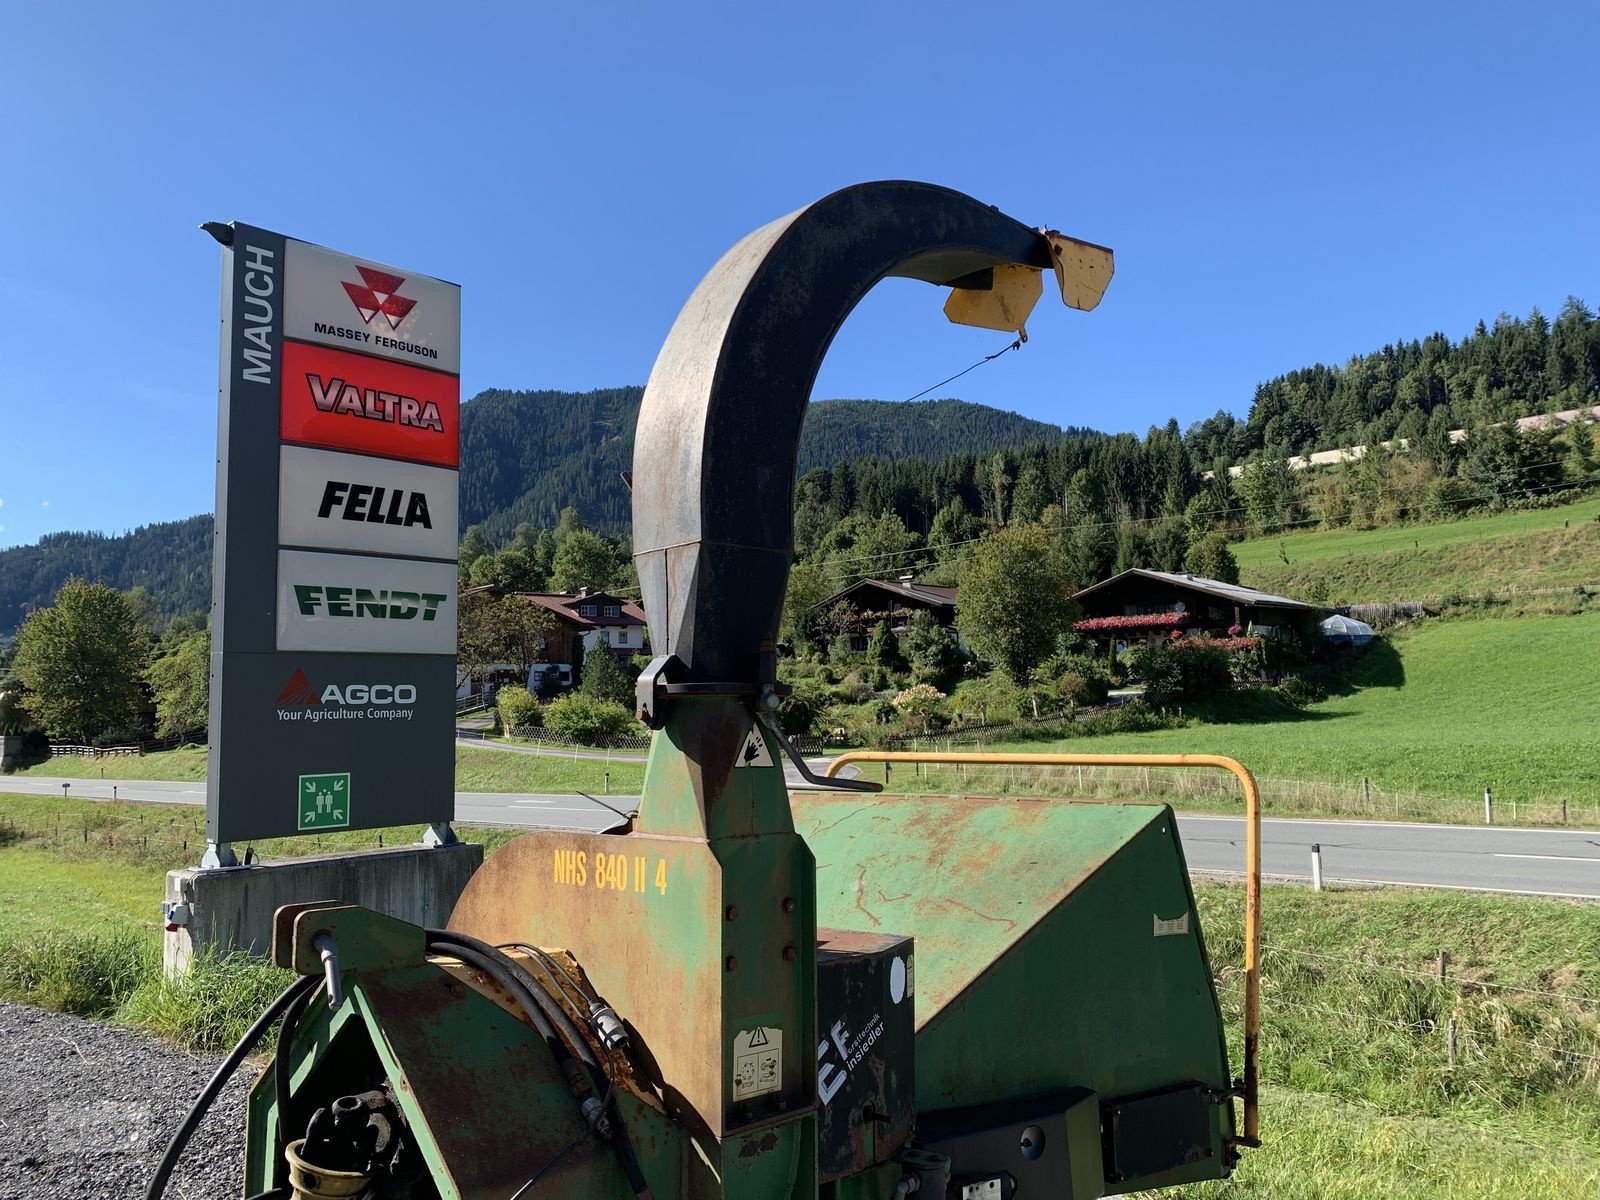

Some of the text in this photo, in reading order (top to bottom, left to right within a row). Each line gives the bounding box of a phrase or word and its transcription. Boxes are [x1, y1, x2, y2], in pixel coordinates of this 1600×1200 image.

[242, 244, 275, 385] MAUCH
[314, 322, 438, 360] MASSEY FERGUSON
[305, 373, 445, 433] VALTRA
[317, 481, 433, 530] FELLA
[293, 584, 448, 621] FENDT
[320, 684, 417, 705] AGCO
[276, 708, 414, 723] Your Agriculture Company
[595, 852, 628, 892] 840
[655, 859, 668, 896] 4
